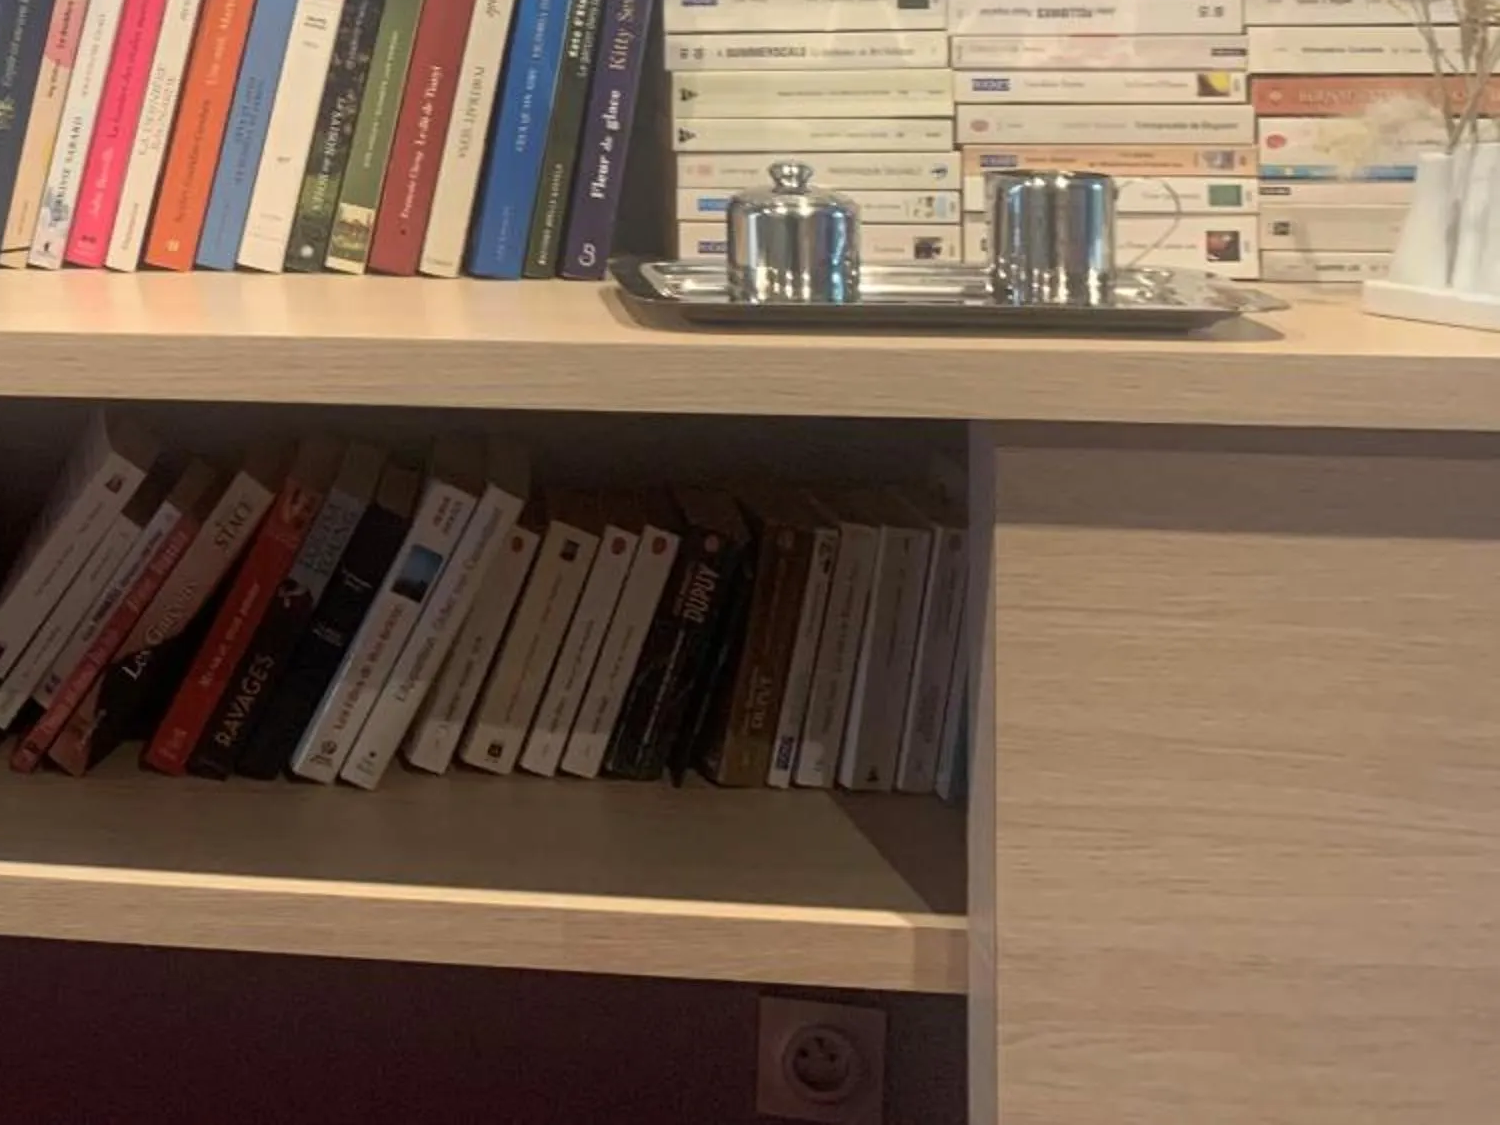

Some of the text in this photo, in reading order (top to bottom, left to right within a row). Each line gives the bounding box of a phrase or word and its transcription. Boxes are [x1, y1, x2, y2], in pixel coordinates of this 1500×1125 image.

[607, 26, 636, 71] Kitty
[588, 88, 626, 200] Fleur de glace
[209, 497, 254, 554] STACE
[678, 560, 721, 625] DUPUY
[212, 649, 277, 751] RAVAGES
